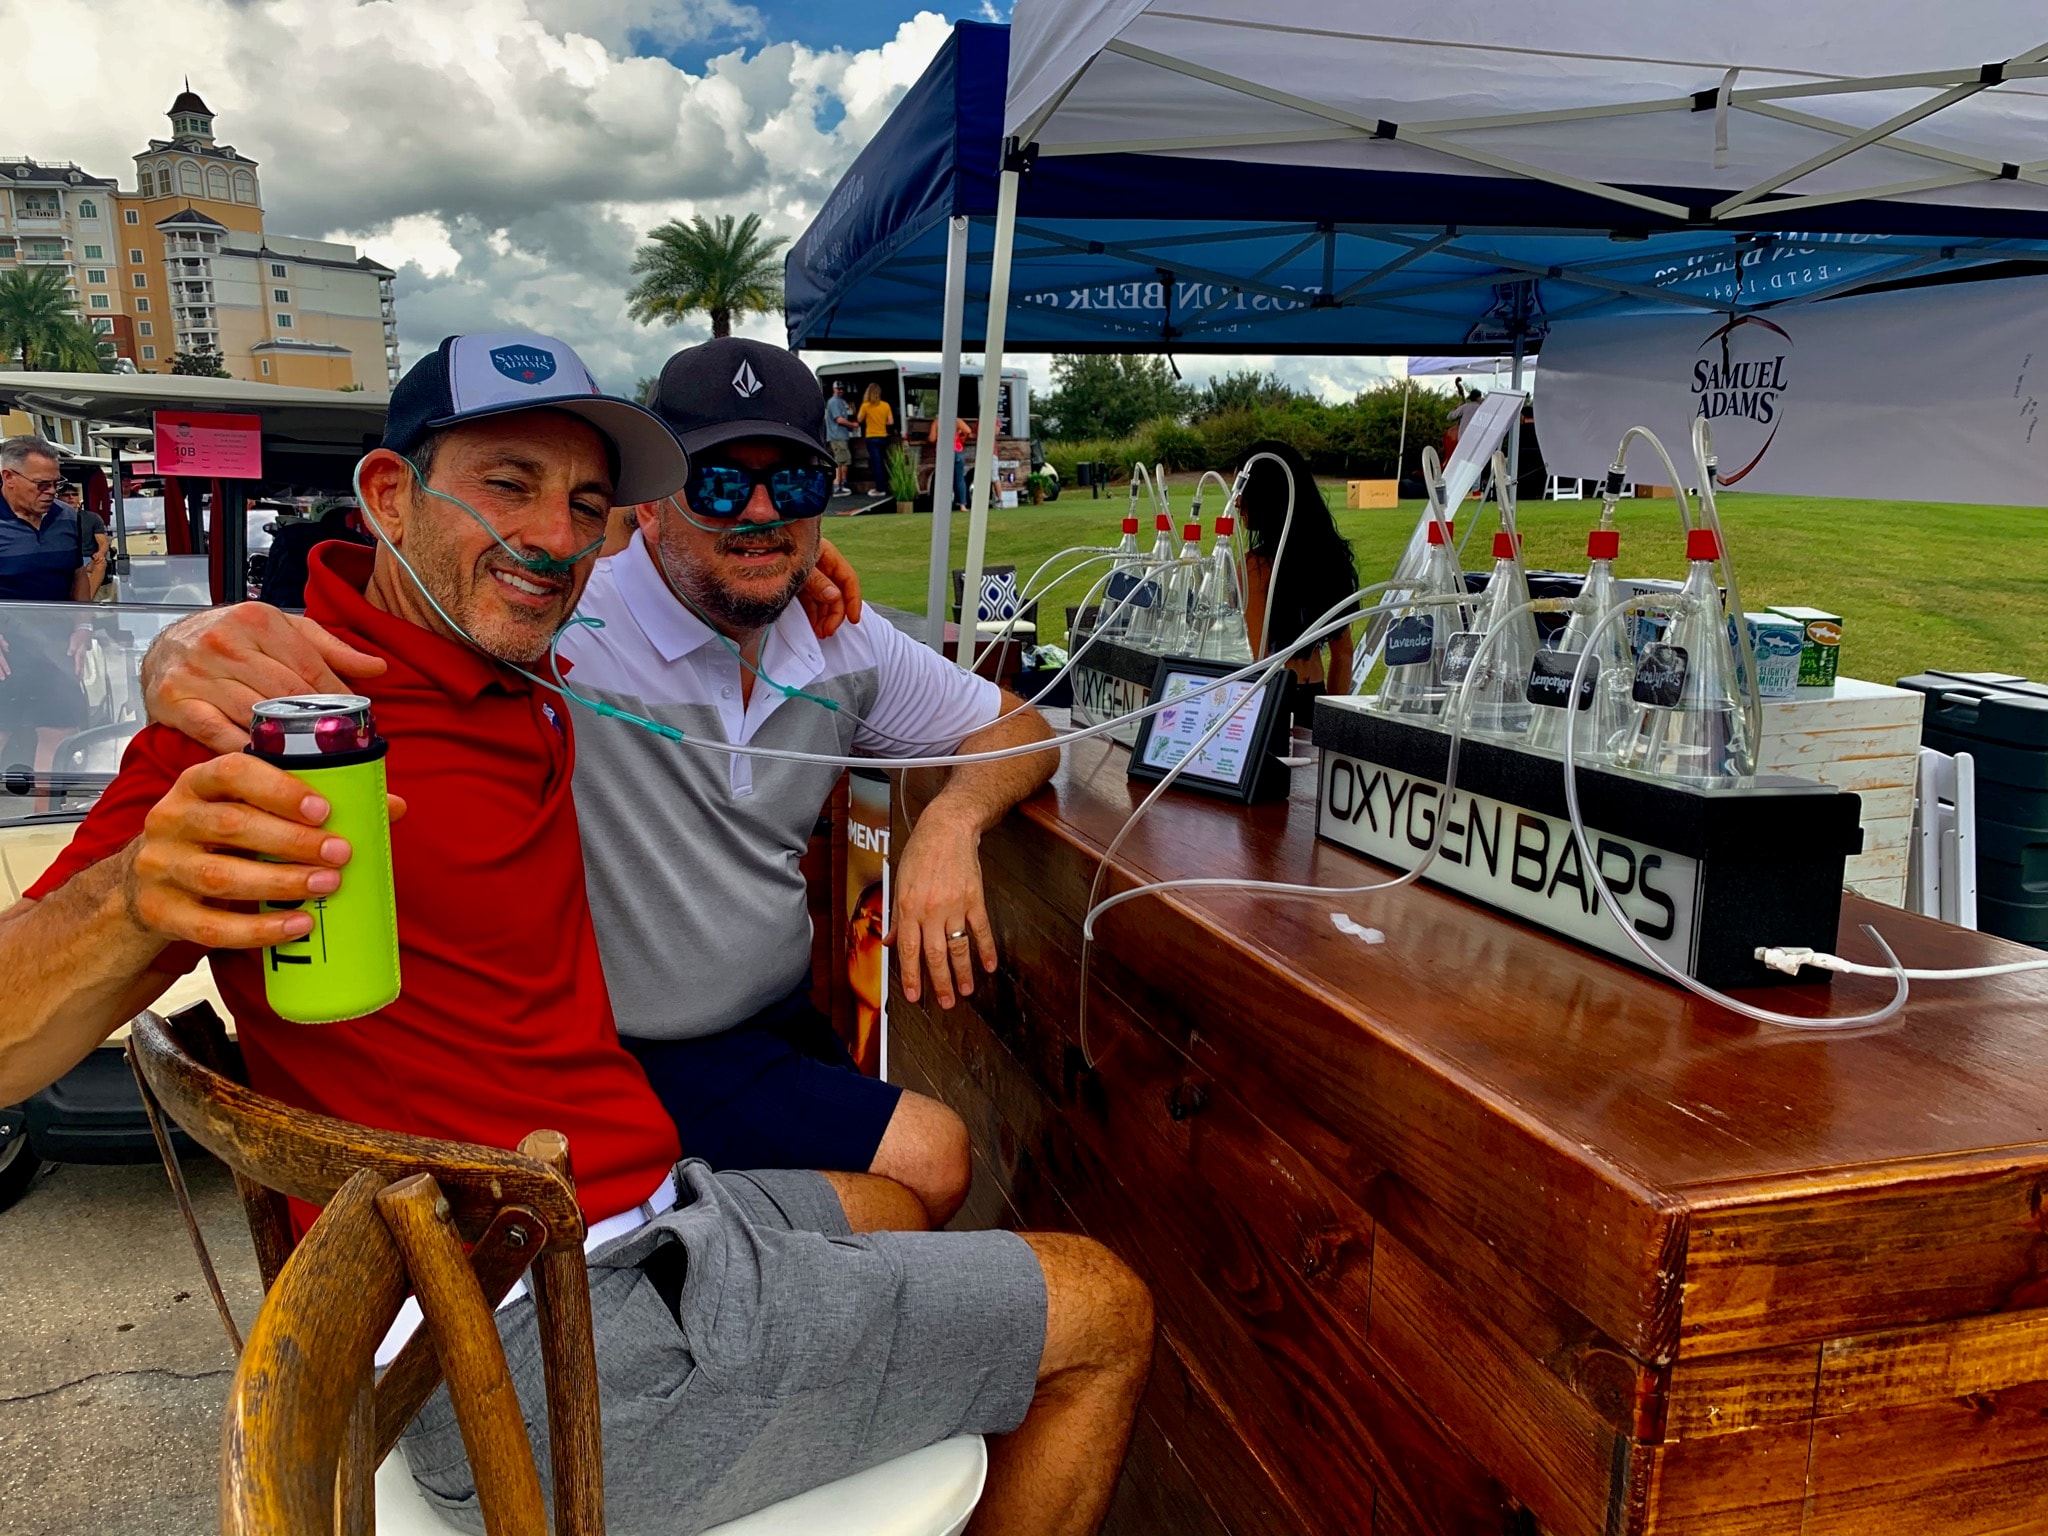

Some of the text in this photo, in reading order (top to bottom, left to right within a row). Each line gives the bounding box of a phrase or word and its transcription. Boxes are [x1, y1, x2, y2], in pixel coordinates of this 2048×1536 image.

[495, 353, 553, 364] SAMUEL
[502, 361, 550, 371] ADAMS
[1691, 356, 1788, 393] SAMUEL
[1697, 391, 1775, 424] ADAMS
[174, 446, 196, 457] 10B
[1389, 634, 1432, 650] Lavender
[1759, 666, 1791, 677] SLIGHTLY
[1530, 670, 1591, 694] Lemongrs
[1759, 676, 1790, 687] MIGHTY
[1076, 665, 1136, 730] OXYGEN
[1328, 758, 1502, 877] OXYGEN
